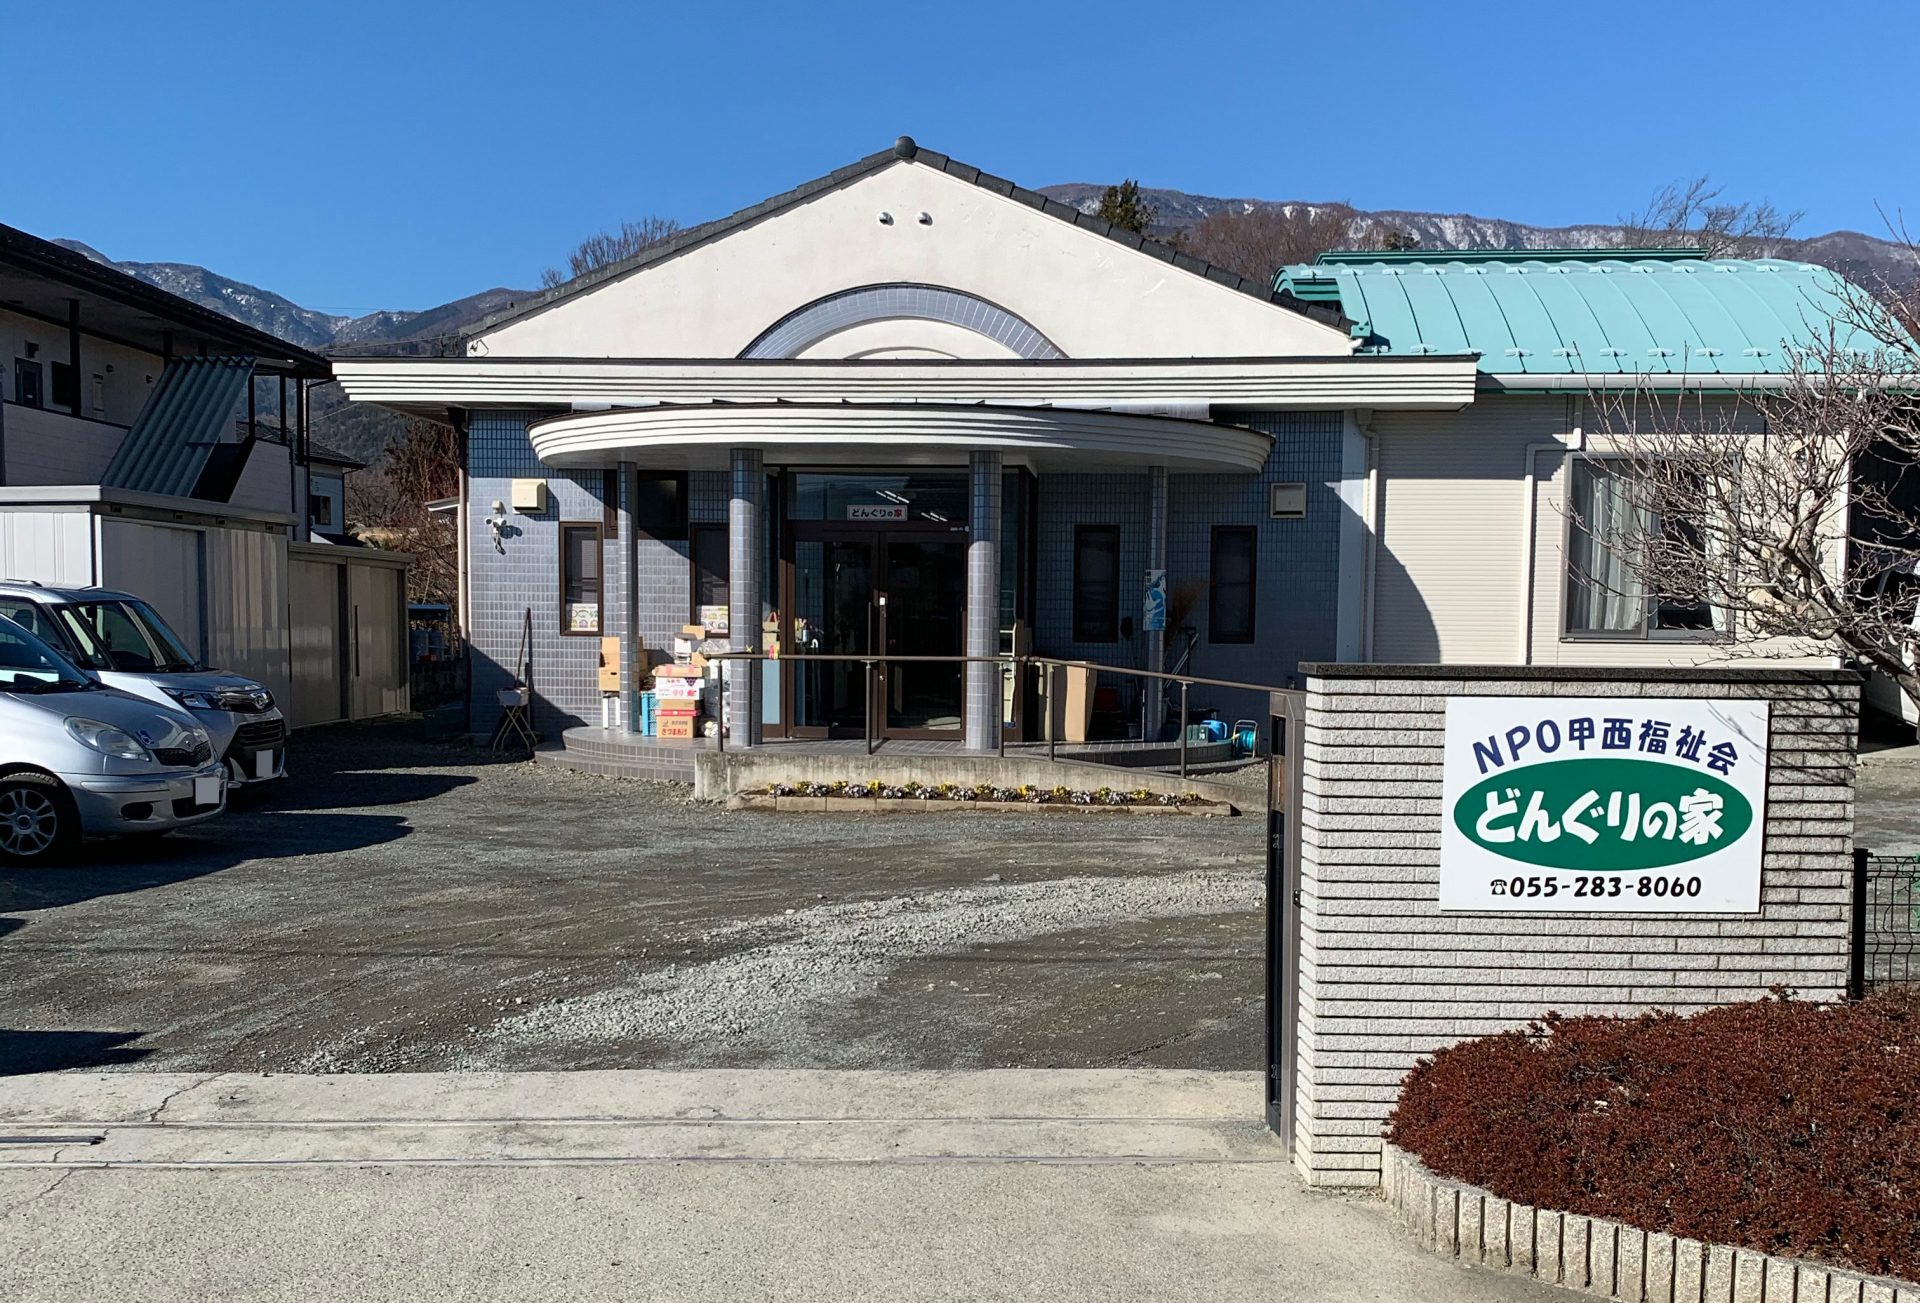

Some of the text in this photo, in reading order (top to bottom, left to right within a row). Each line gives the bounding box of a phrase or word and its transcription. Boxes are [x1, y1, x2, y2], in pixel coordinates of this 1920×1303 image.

[851, 508, 903, 518] どんぐりの家
[1472, 717, 1739, 776] NPO甲西福祉会
[1475, 787, 1724, 845] どんぐりの家
[1509, 876, 1702, 898] 055-283-8060
